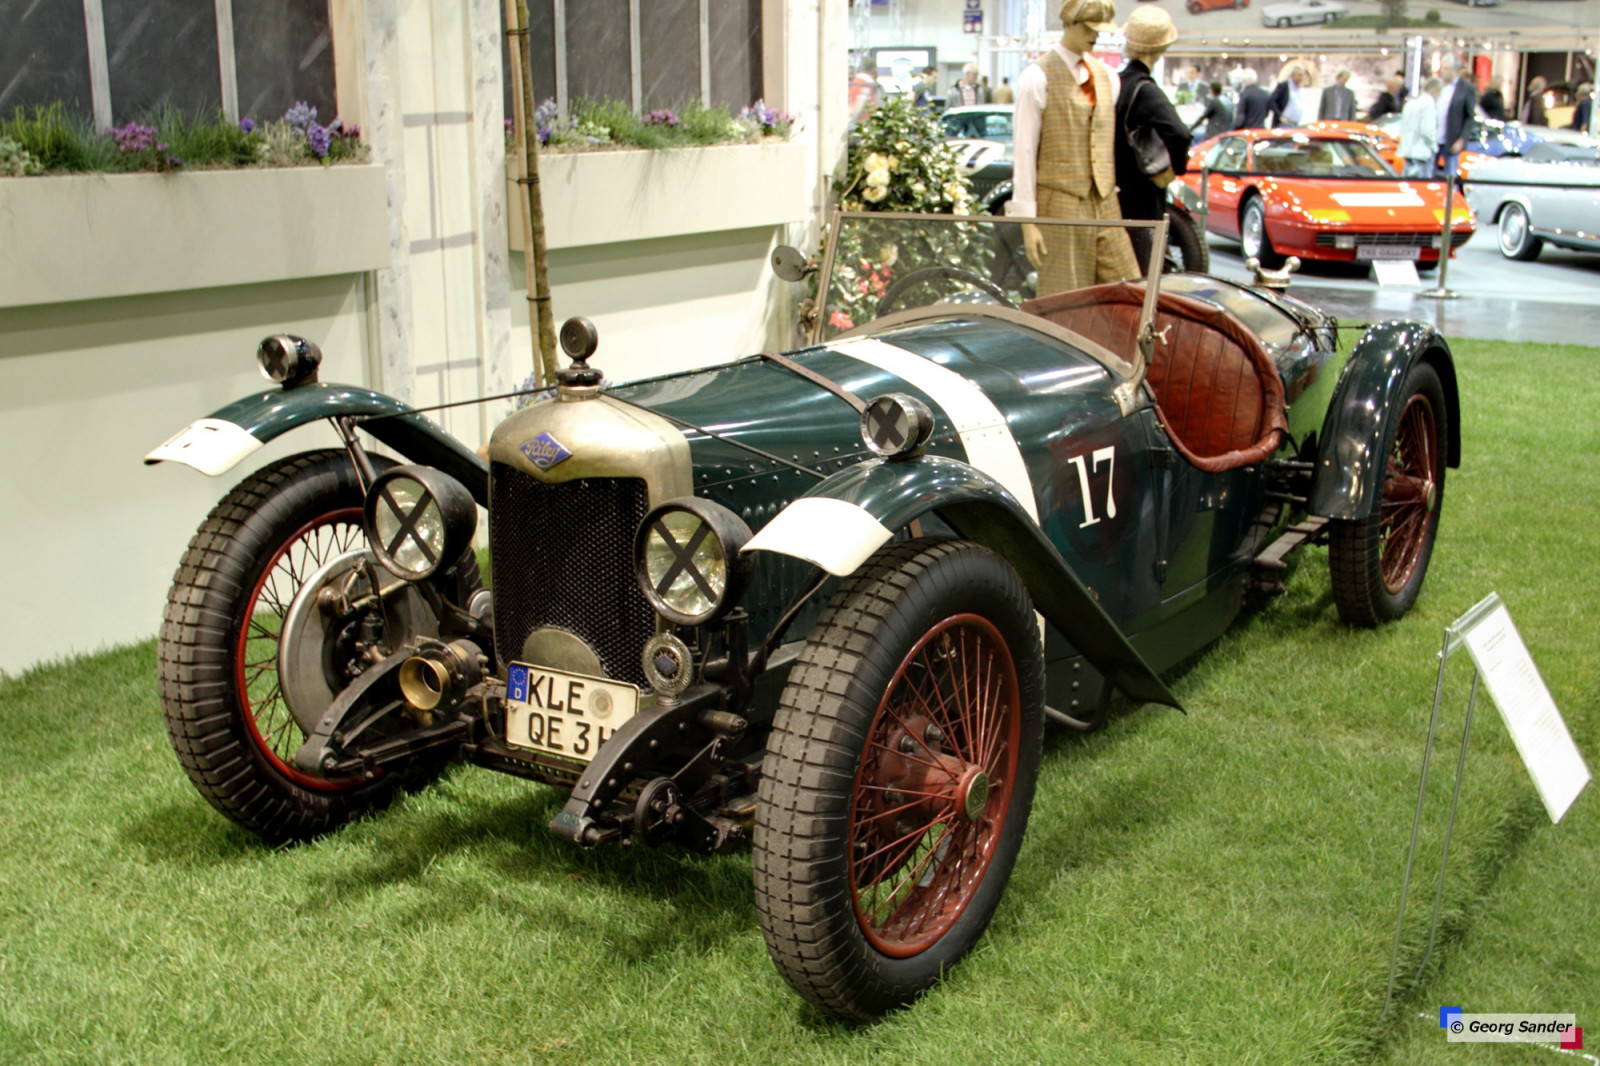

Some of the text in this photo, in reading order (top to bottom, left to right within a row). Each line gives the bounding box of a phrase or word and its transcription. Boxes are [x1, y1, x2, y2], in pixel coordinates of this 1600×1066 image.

[1361, 248, 1417, 257] THE GALLERY
[525, 440, 561, 468] Riley
[1067, 445, 1117, 528] 17
[513, 689, 522, 699] D
[527, 672, 585, 716] KLE
[528, 712, 564, 751] QE
